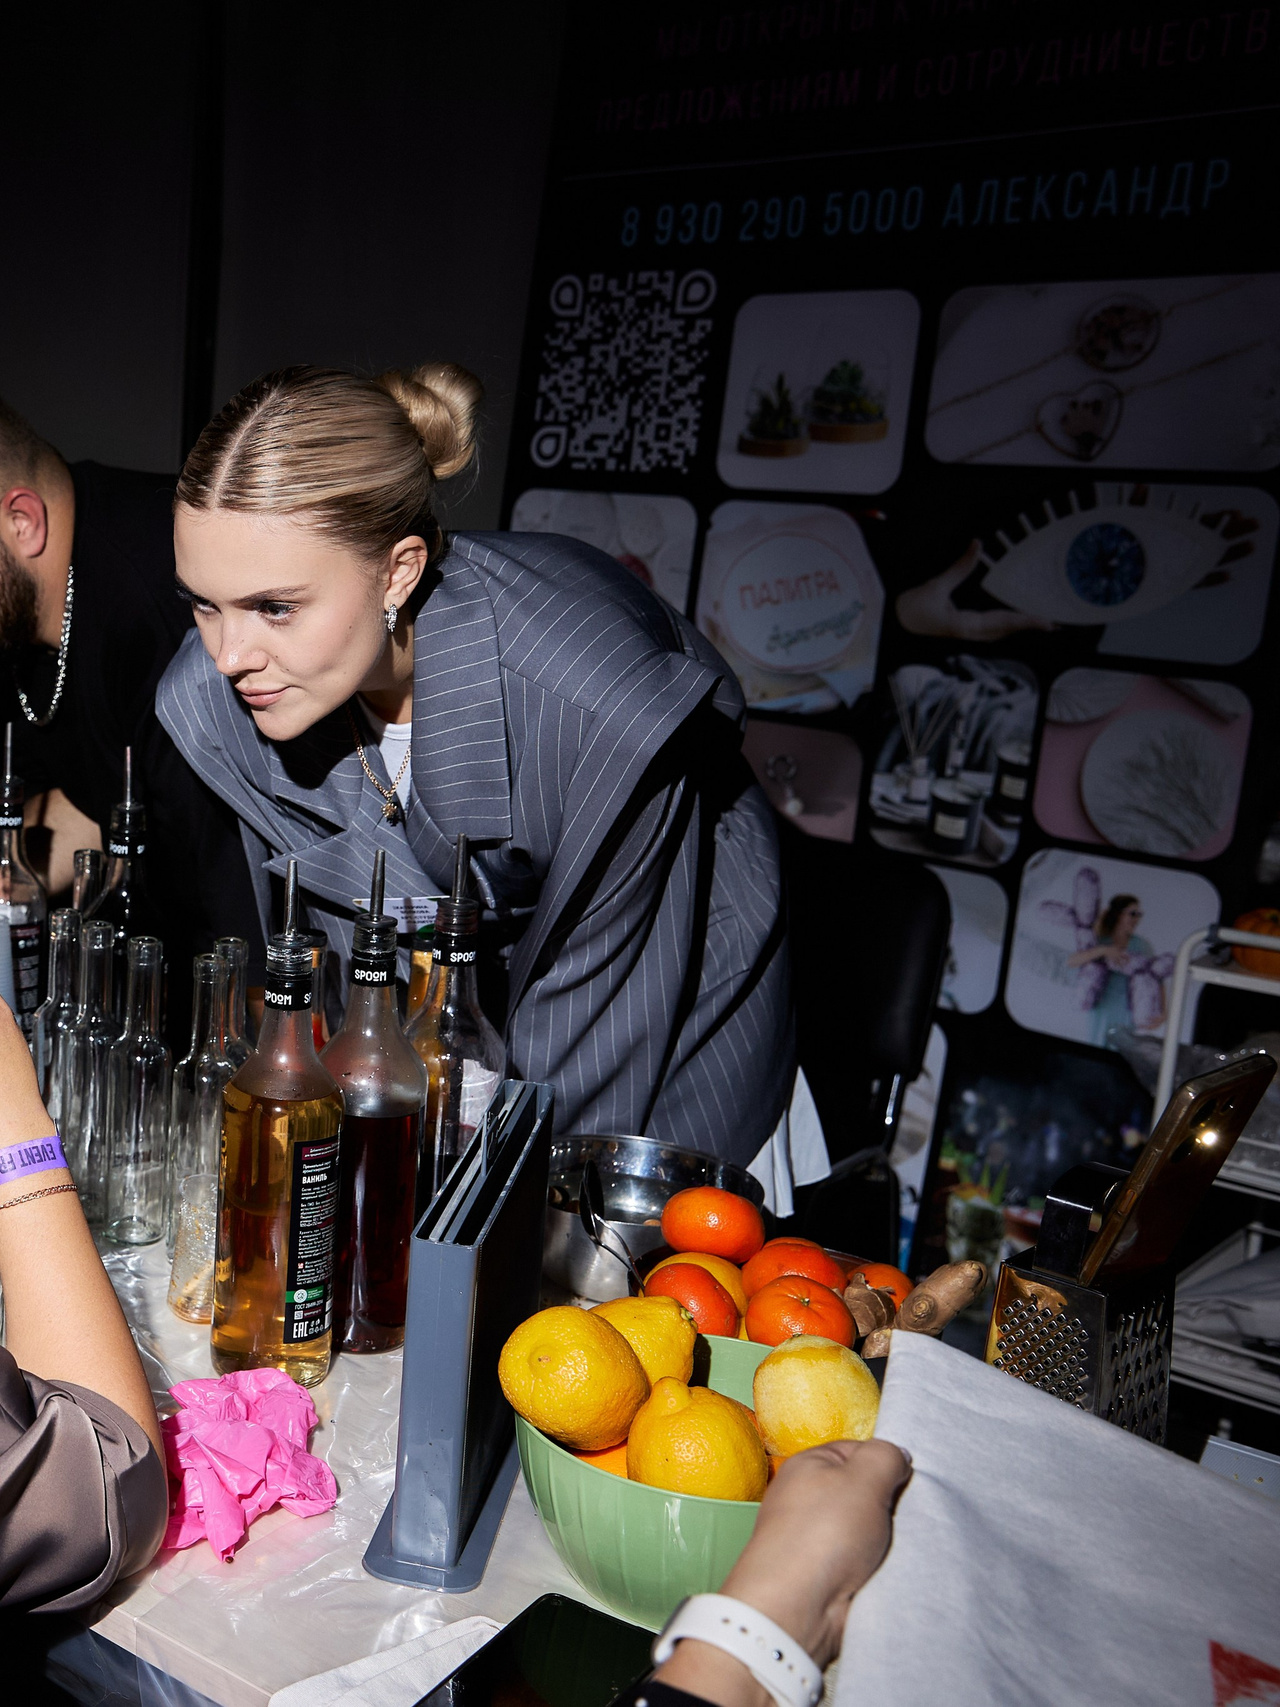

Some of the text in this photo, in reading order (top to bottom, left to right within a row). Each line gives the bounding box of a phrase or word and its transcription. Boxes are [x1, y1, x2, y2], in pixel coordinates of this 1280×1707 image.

[655, 20, 702, 58] МЫ
[716, 0, 876, 53] ОТКРЫТЫ
[595, 68, 861, 131] ПРЕДЛОЖЕНИЯМ
[876, 62, 900, 101] И
[620, 156, 1232, 248] 8 930 290 5000 АЛЕКСАНДР
[354, 969, 387, 983] SPOOM
[18, 1143, 57, 1168] EVENT
[302, 1173, 328, 1184] ВАНИЛЬ
